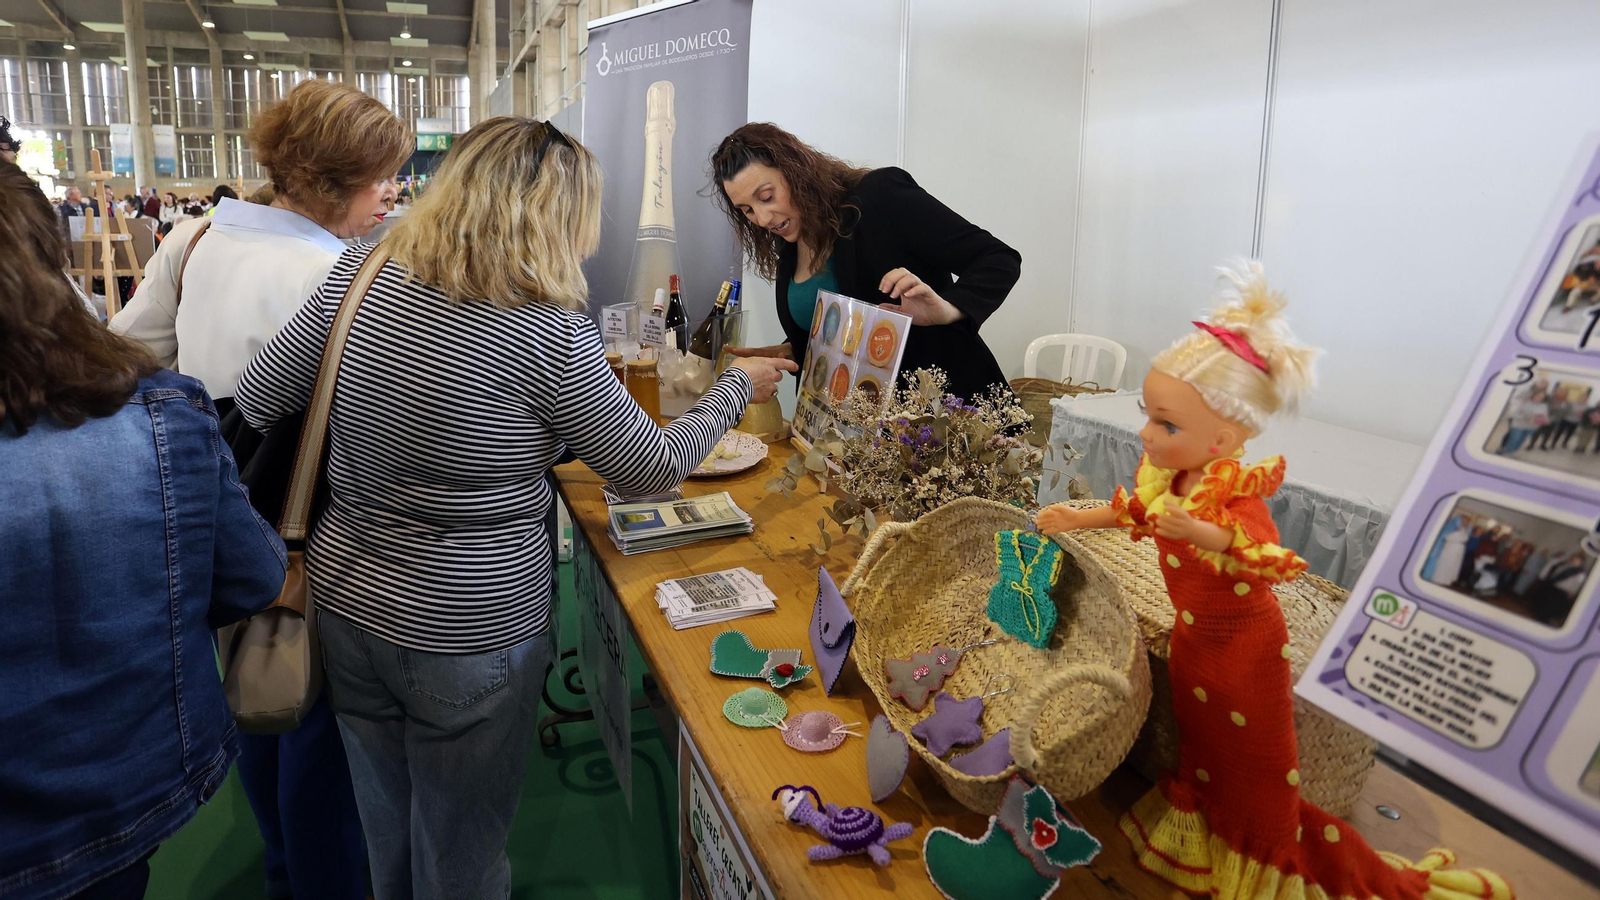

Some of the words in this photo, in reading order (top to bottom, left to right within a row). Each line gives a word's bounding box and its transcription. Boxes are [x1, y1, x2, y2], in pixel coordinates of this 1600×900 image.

[614, 42, 662, 67] MIGUEL
[666, 28, 738, 56] DOMECQ
[644, 61, 660, 69] FAMILIAR
[1504, 354, 1538, 386] 3
[1443, 654, 1456, 665] LA
[1398, 660, 1432, 679] TEATRO
[1432, 688, 1446, 699] LA
[1397, 697, 1411, 708] LA
[694, 788, 720, 851] TALLERES
